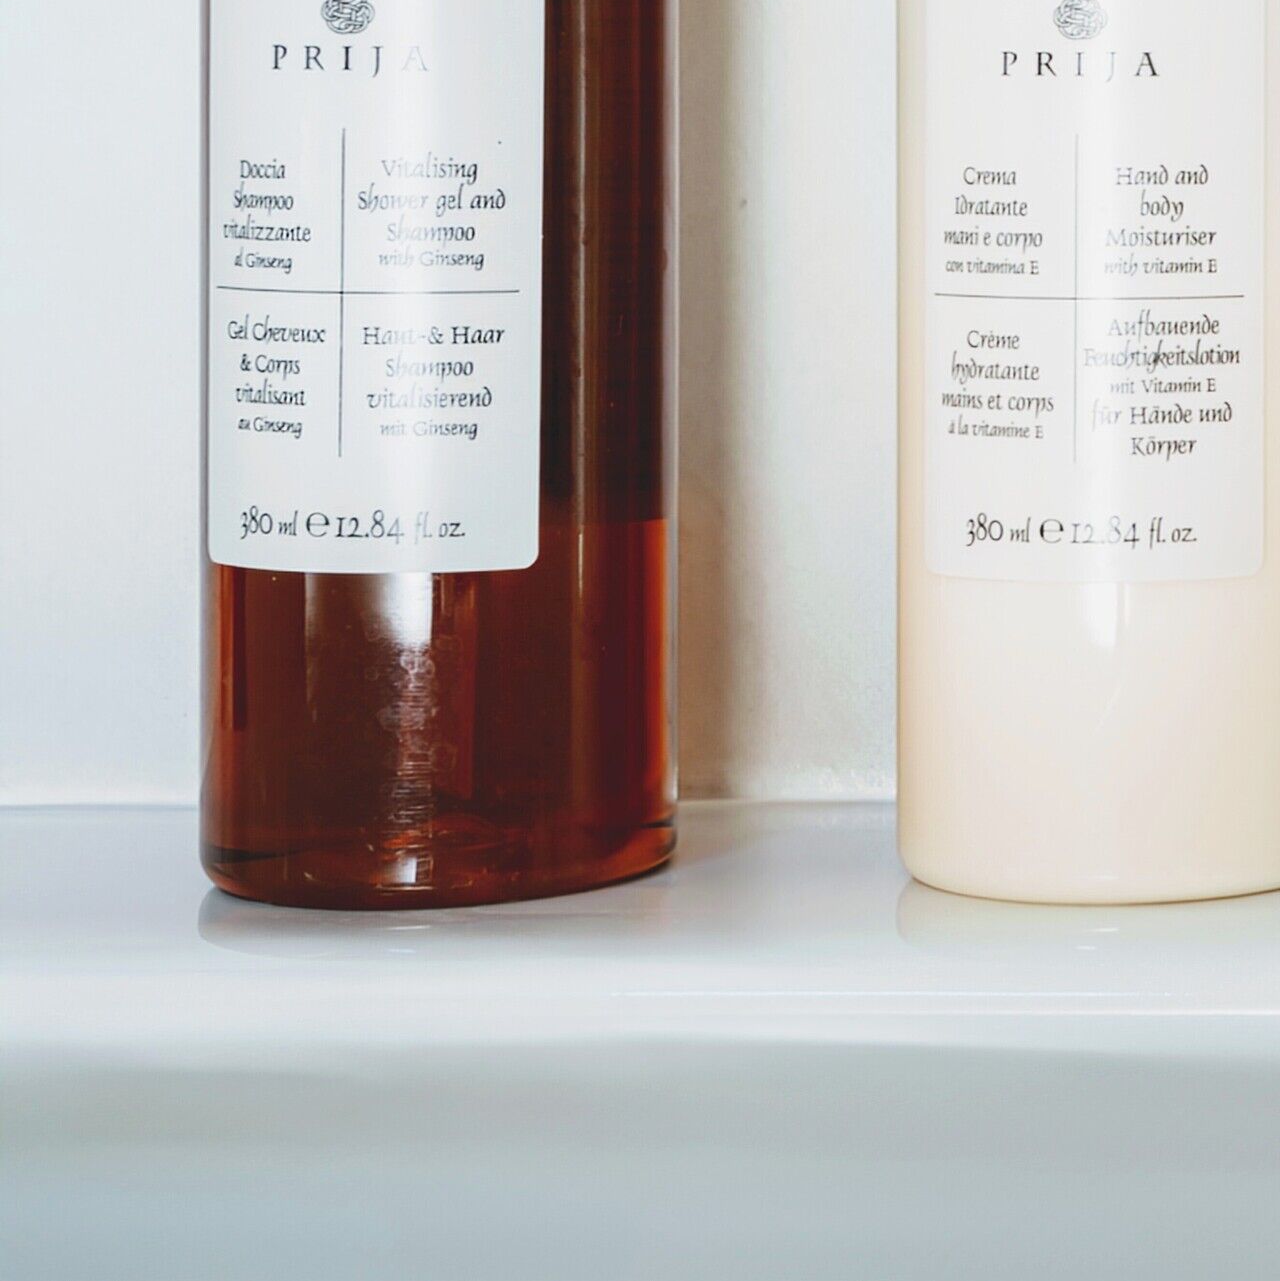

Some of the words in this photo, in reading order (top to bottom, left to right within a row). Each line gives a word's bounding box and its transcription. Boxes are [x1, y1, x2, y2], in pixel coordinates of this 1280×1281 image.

[271, 44, 429, 78] PRIJA
[1000, 50, 1160, 83] PRIJA
[239, 158, 287, 180] Doccia
[380, 151, 479, 186] Vitalising
[962, 166, 1018, 186] Crema
[1114, 164, 1170, 186] Hand
[1174, 163, 1210, 186] and
[233, 180, 295, 216] Shampoo
[357, 181, 429, 214] Shower
[435, 182, 465, 218] gel
[469, 187, 507, 210] and
[953, 193, 1029, 217] Idratante
[1138, 188, 1185, 223] body
[222, 212, 312, 242] vitalizzante
[386, 213, 476, 247] Shampoo
[943, 225, 980, 246] mani
[982, 231, 992, 246] e
[995, 230, 1044, 255] corpo
[1104, 224, 1218, 247] Moisturiser
[245, 251, 293, 275] Ginseng
[418, 249, 485, 271] Ginseng
[944, 259, 964, 274] con
[965, 256, 1026, 275] vitamina
[1028, 259, 1040, 276] E
[1103, 251, 1139, 277] with
[1141, 256, 1203, 275] vitamin
[1206, 258, 1218, 274] E
[227, 313, 249, 340] Gel
[252, 314, 326, 345] Cheveux
[450, 325, 506, 345] Haar
[1107, 308, 1221, 344] Aufbauende
[254, 353, 301, 382] Corps
[385, 350, 475, 384] Shampoo
[951, 349, 1041, 385] hydratante
[1082, 338, 1241, 375] Feuchtigkeitslotion
[235, 378, 307, 407] vitalisant
[366, 382, 493, 409] vitalisierend
[1109, 378, 1136, 395] mit
[1140, 376, 1202, 394] Vitamin
[1206, 377, 1217, 393] E
[941, 386, 983, 410] mains
[987, 394, 1003, 410] et
[1007, 395, 1055, 420] corps
[1091, 398, 1123, 433] für
[1129, 403, 1193, 426] Hände
[1199, 401, 1233, 423] und
[252, 416, 303, 440] Ginseng
[412, 419, 479, 441] Ginseng
[957, 413, 969, 436] la
[971, 419, 1031, 439] vitamine
[1034, 425, 1045, 439] E
[1130, 435, 1198, 463] Körper
[239, 504, 274, 540] 380
[277, 509, 299, 537] ml
[965, 511, 1005, 548] 380
[1009, 516, 1032, 543] ml
[1148, 516, 1167, 551] fl.
